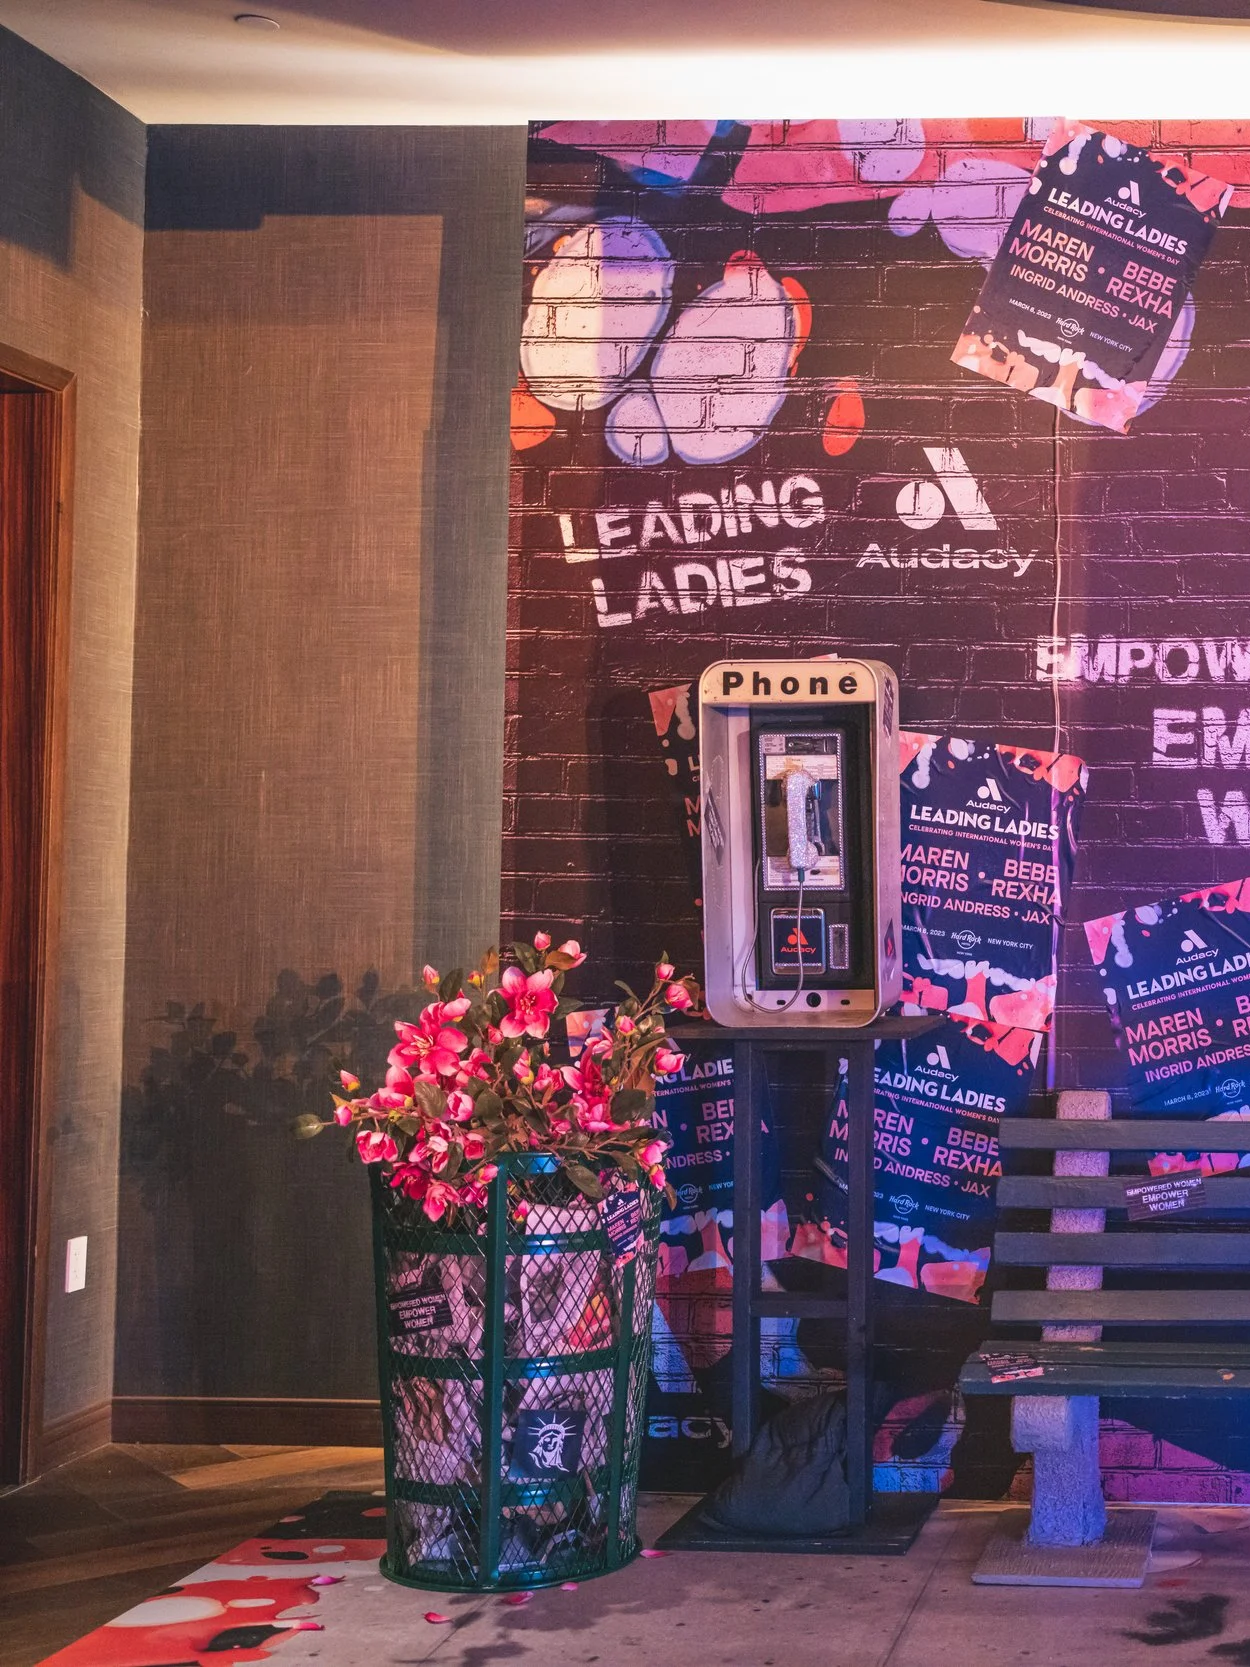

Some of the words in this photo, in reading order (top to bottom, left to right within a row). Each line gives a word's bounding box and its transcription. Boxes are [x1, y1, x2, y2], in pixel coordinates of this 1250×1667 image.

[1048, 188, 1123, 229] LEADING
[1124, 219, 1188, 255] LADIES
[1104, 197, 1147, 218] Audacy
[1020, 219, 1095, 262] MAREN
[1044, 206, 1085, 227] CELEBRATING
[1086, 224, 1135, 248] INTERNATIONAL
[1136, 244, 1166, 261] WOMEN'S
[1167, 257, 1180, 265] DAY
[1009, 237, 1089, 282] MORRIS
[1123, 261, 1177, 295] BEBE
[1009, 299, 1029, 312] MARCH
[1036, 309, 1052, 319] 2023
[1010, 265, 1056, 291] INGRID
[1056, 284, 1120, 317] ANDRESS
[1129, 315, 1158, 333] JAX
[1106, 277, 1173, 319] REXHA
[1090, 332, 1104, 342] NEW
[1104, 338, 1119, 347] YORK
[1119, 343, 1132, 352] CITY
[559, 474, 825, 564] LEADING
[856, 542, 1039, 578] Audacy
[591, 546, 813, 628] LADIES
[723, 672, 858, 696] Phone
[966, 800, 1011, 813] Audacy
[909, 825, 953, 836] CELEBRATING
[955, 831, 1007, 844] INTERNATIONAL
[1010, 839, 1041, 849] WOMEN'S
[911, 805, 990, 829] LEADING
[994, 817, 1059, 840] LADIES
[1004, 859, 1059, 883] BEBE
[992, 879, 1062, 906] REXHA
[901, 892, 941, 908] NGRID
[944, 898, 1011, 918] ANDRESS
[1022, 910, 1050, 925] JAX
[1176, 949, 1219, 965] Audacy
[1126, 966, 1207, 1000] LEADING
[1132, 994, 1176, 1011] CELEBRATING
[1178, 981, 1230, 998] INTERNATIONAL
[1125, 1008, 1203, 1044] MAREN
[1128, 1029, 1212, 1066] MORRIS
[681, 1058, 734, 1082] LADIE
[915, 1066, 959, 1082] Audacy
[1145, 1061, 1193, 1083] INGRID
[700, 1080, 731, 1090] WOMEN'S
[874, 1067, 938, 1094] EADING
[940, 1085, 1006, 1112] LADIES
[902, 1096, 953, 1113] INTERNATIONAL
[955, 1108, 986, 1120] WOMEN'S
[947, 1127, 999, 1156] BEBE
[933, 1146, 1003, 1176] REXHA
[884, 1163, 950, 1187] ANDRESS
[961, 1180, 991, 1197] JAX
[1126, 1184, 1172, 1196] EMPOWERED
[1174, 1178, 1201, 1187] WOMEN
[1142, 1189, 1189, 1203] EMPOWER
[1149, 1199, 1184, 1211] WOMEN
[399, 1306, 436, 1319] EMPOWER
[404, 1316, 433, 1328] WOMEN
